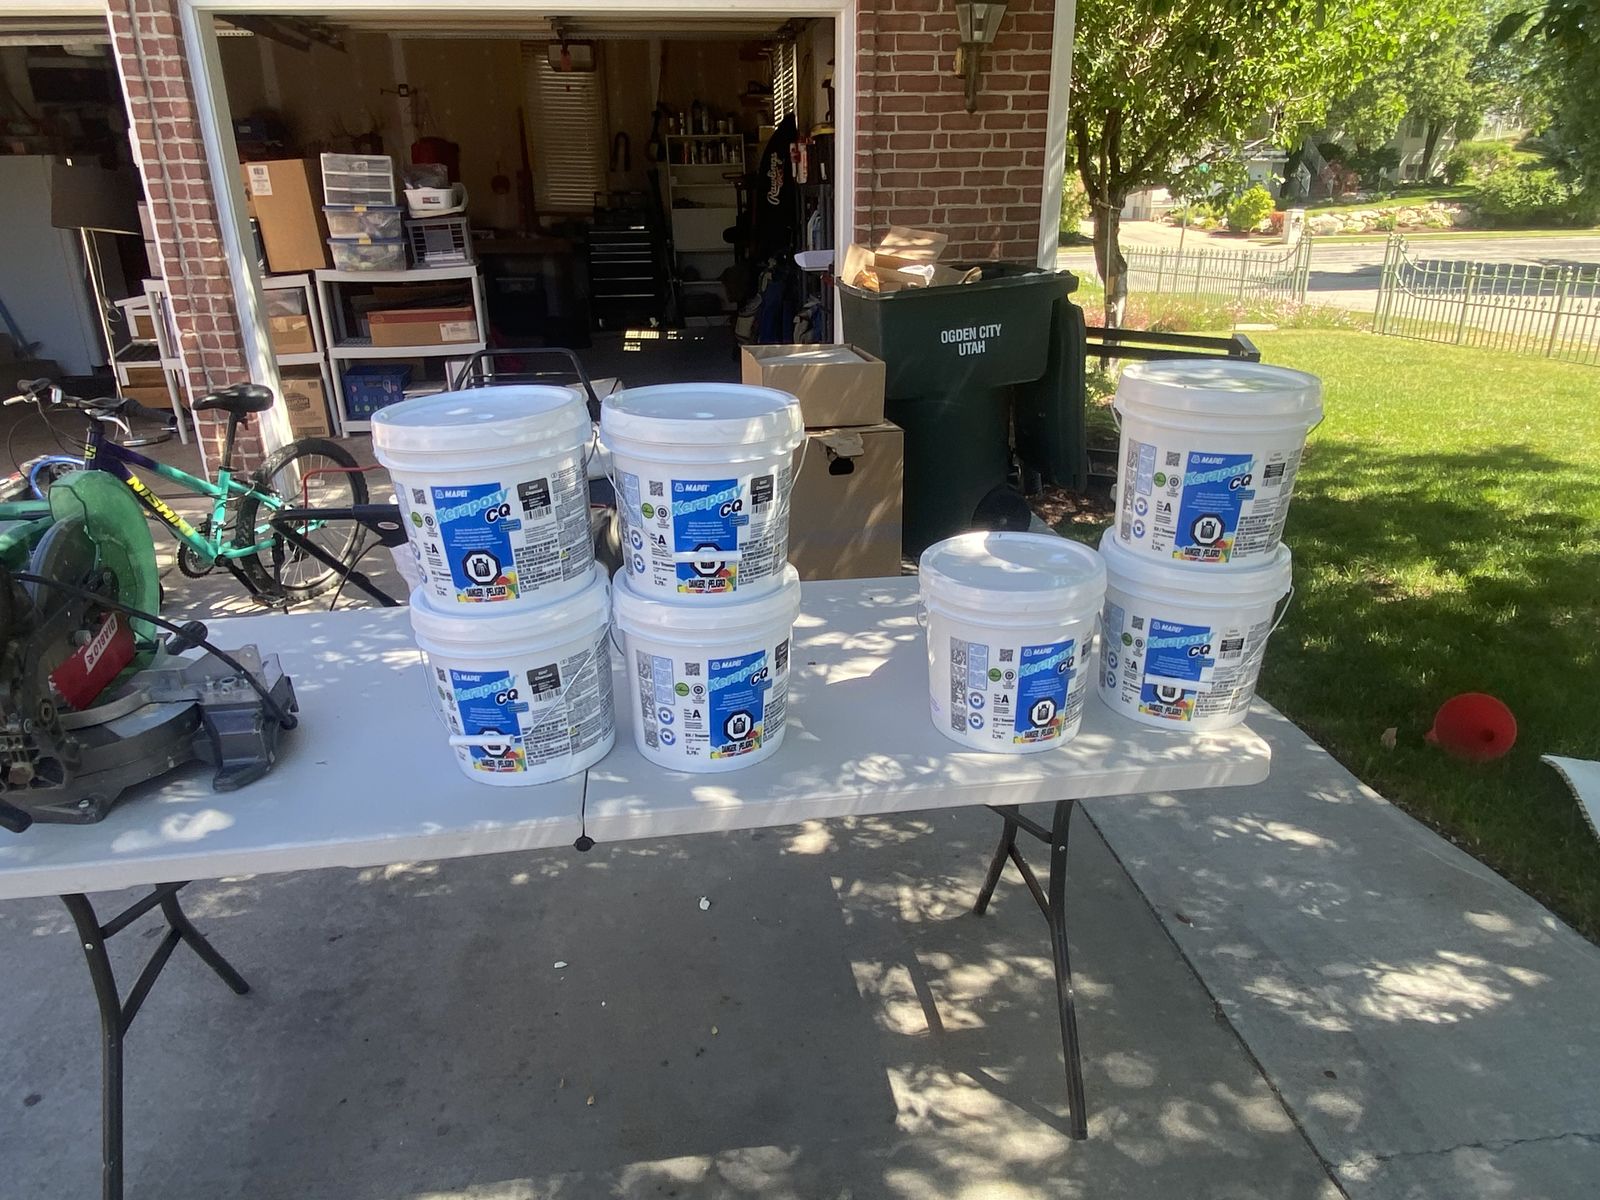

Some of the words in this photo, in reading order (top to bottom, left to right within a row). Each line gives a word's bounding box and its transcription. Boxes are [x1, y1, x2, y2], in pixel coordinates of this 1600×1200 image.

[767, 152, 783, 206] Rawlings
[941, 326, 977, 344] OGDEN
[979, 323, 1002, 339] CITY
[959, 340, 986, 356] UTAH
[1184, 460, 1255, 486] Kerapoxy
[1229, 473, 1252, 491] CQ
[444, 490, 468, 498] MAPEI
[685, 484, 708, 492] MAPEI
[436, 488, 510, 523] Kerapoxy
[672, 485, 745, 517] Kerapoxy
[719, 499, 743, 518] CQ
[1164, 502, 1172, 513] A
[485, 503, 511, 524] CQ
[431, 543, 439, 554] A
[658, 534, 667, 545] A
[92, 618, 117, 657] DIABLO
[1147, 632, 1214, 649] Kerapoxy
[1187, 644, 1211, 658] CQ
[1018, 644, 1075, 678] Kerapoxy
[1057, 656, 1075, 674] CQ
[708, 654, 770, 692] Kerapoxy
[750, 666, 768, 686] CQ
[454, 675, 515, 701] Kerapoxy
[495, 688, 519, 706] CQ
[1001, 694, 1009, 704] A
[692, 709, 701, 718] A
